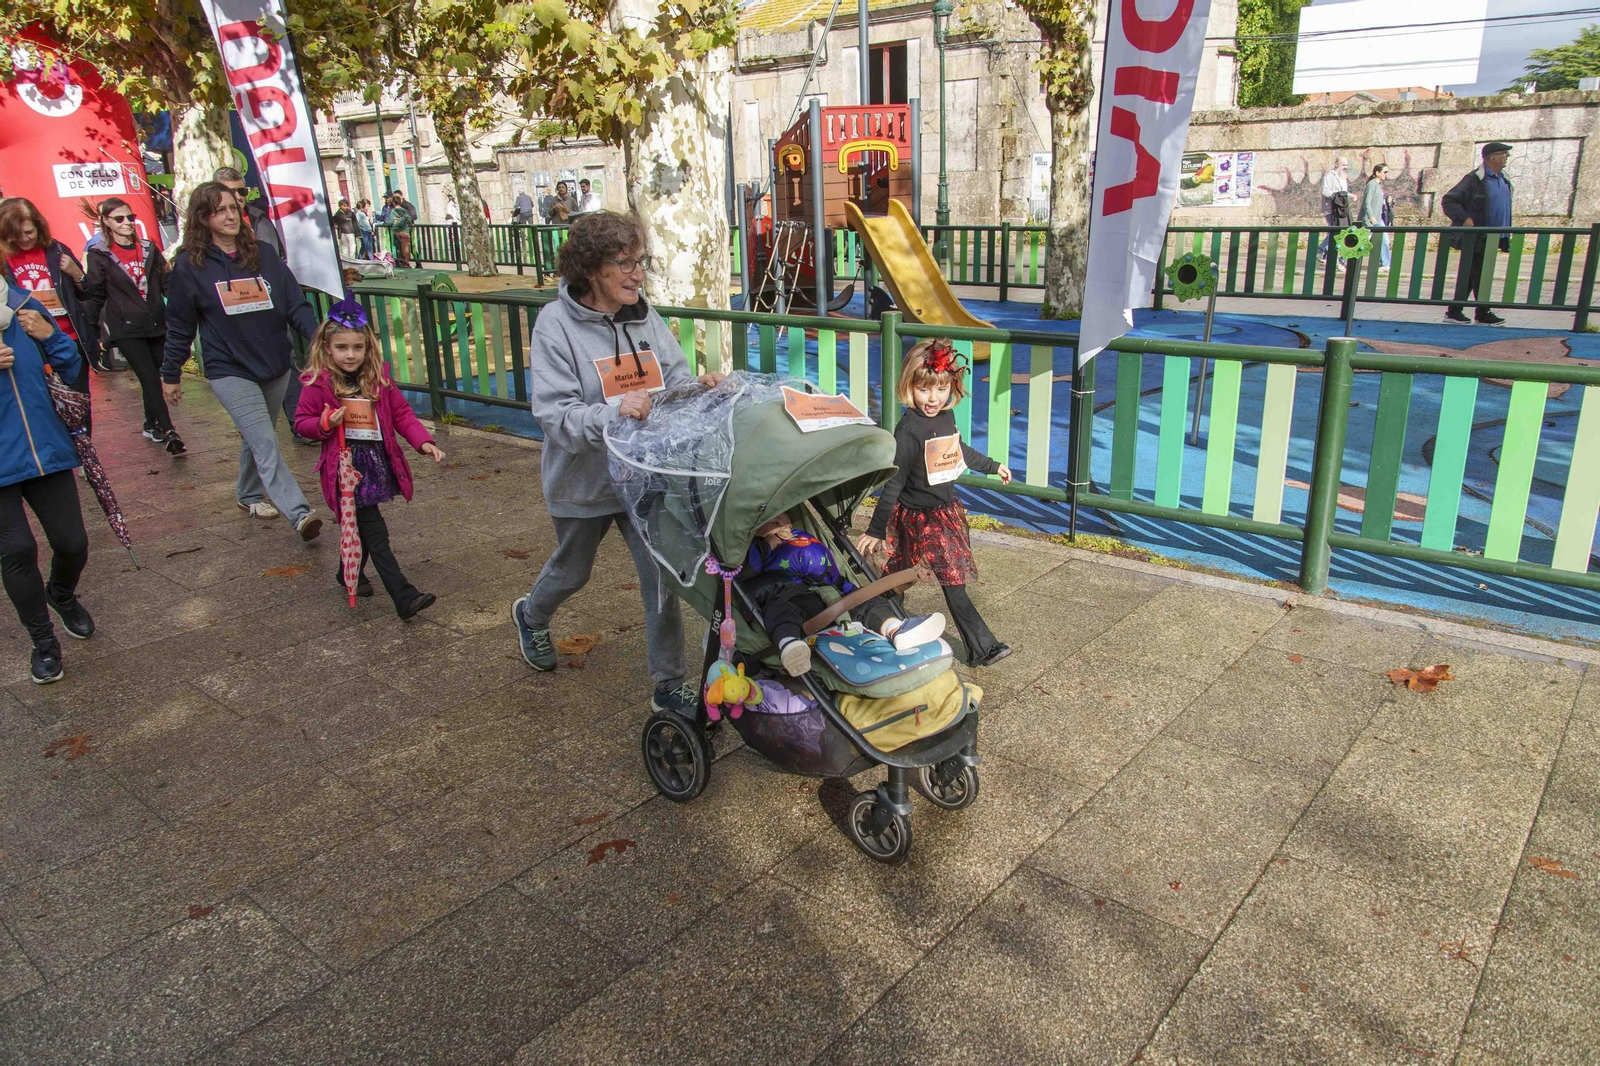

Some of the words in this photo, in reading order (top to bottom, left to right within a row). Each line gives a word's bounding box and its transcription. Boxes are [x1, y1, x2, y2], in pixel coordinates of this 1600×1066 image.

[60, 169, 118, 180] CONCELLO
[69, 180, 85, 189] DE
[88, 179, 114, 188] VIGO
[614, 372, 633, 383] Maria
[703, 477, 722, 486] Joie
[711, 609, 722, 636] Joie
